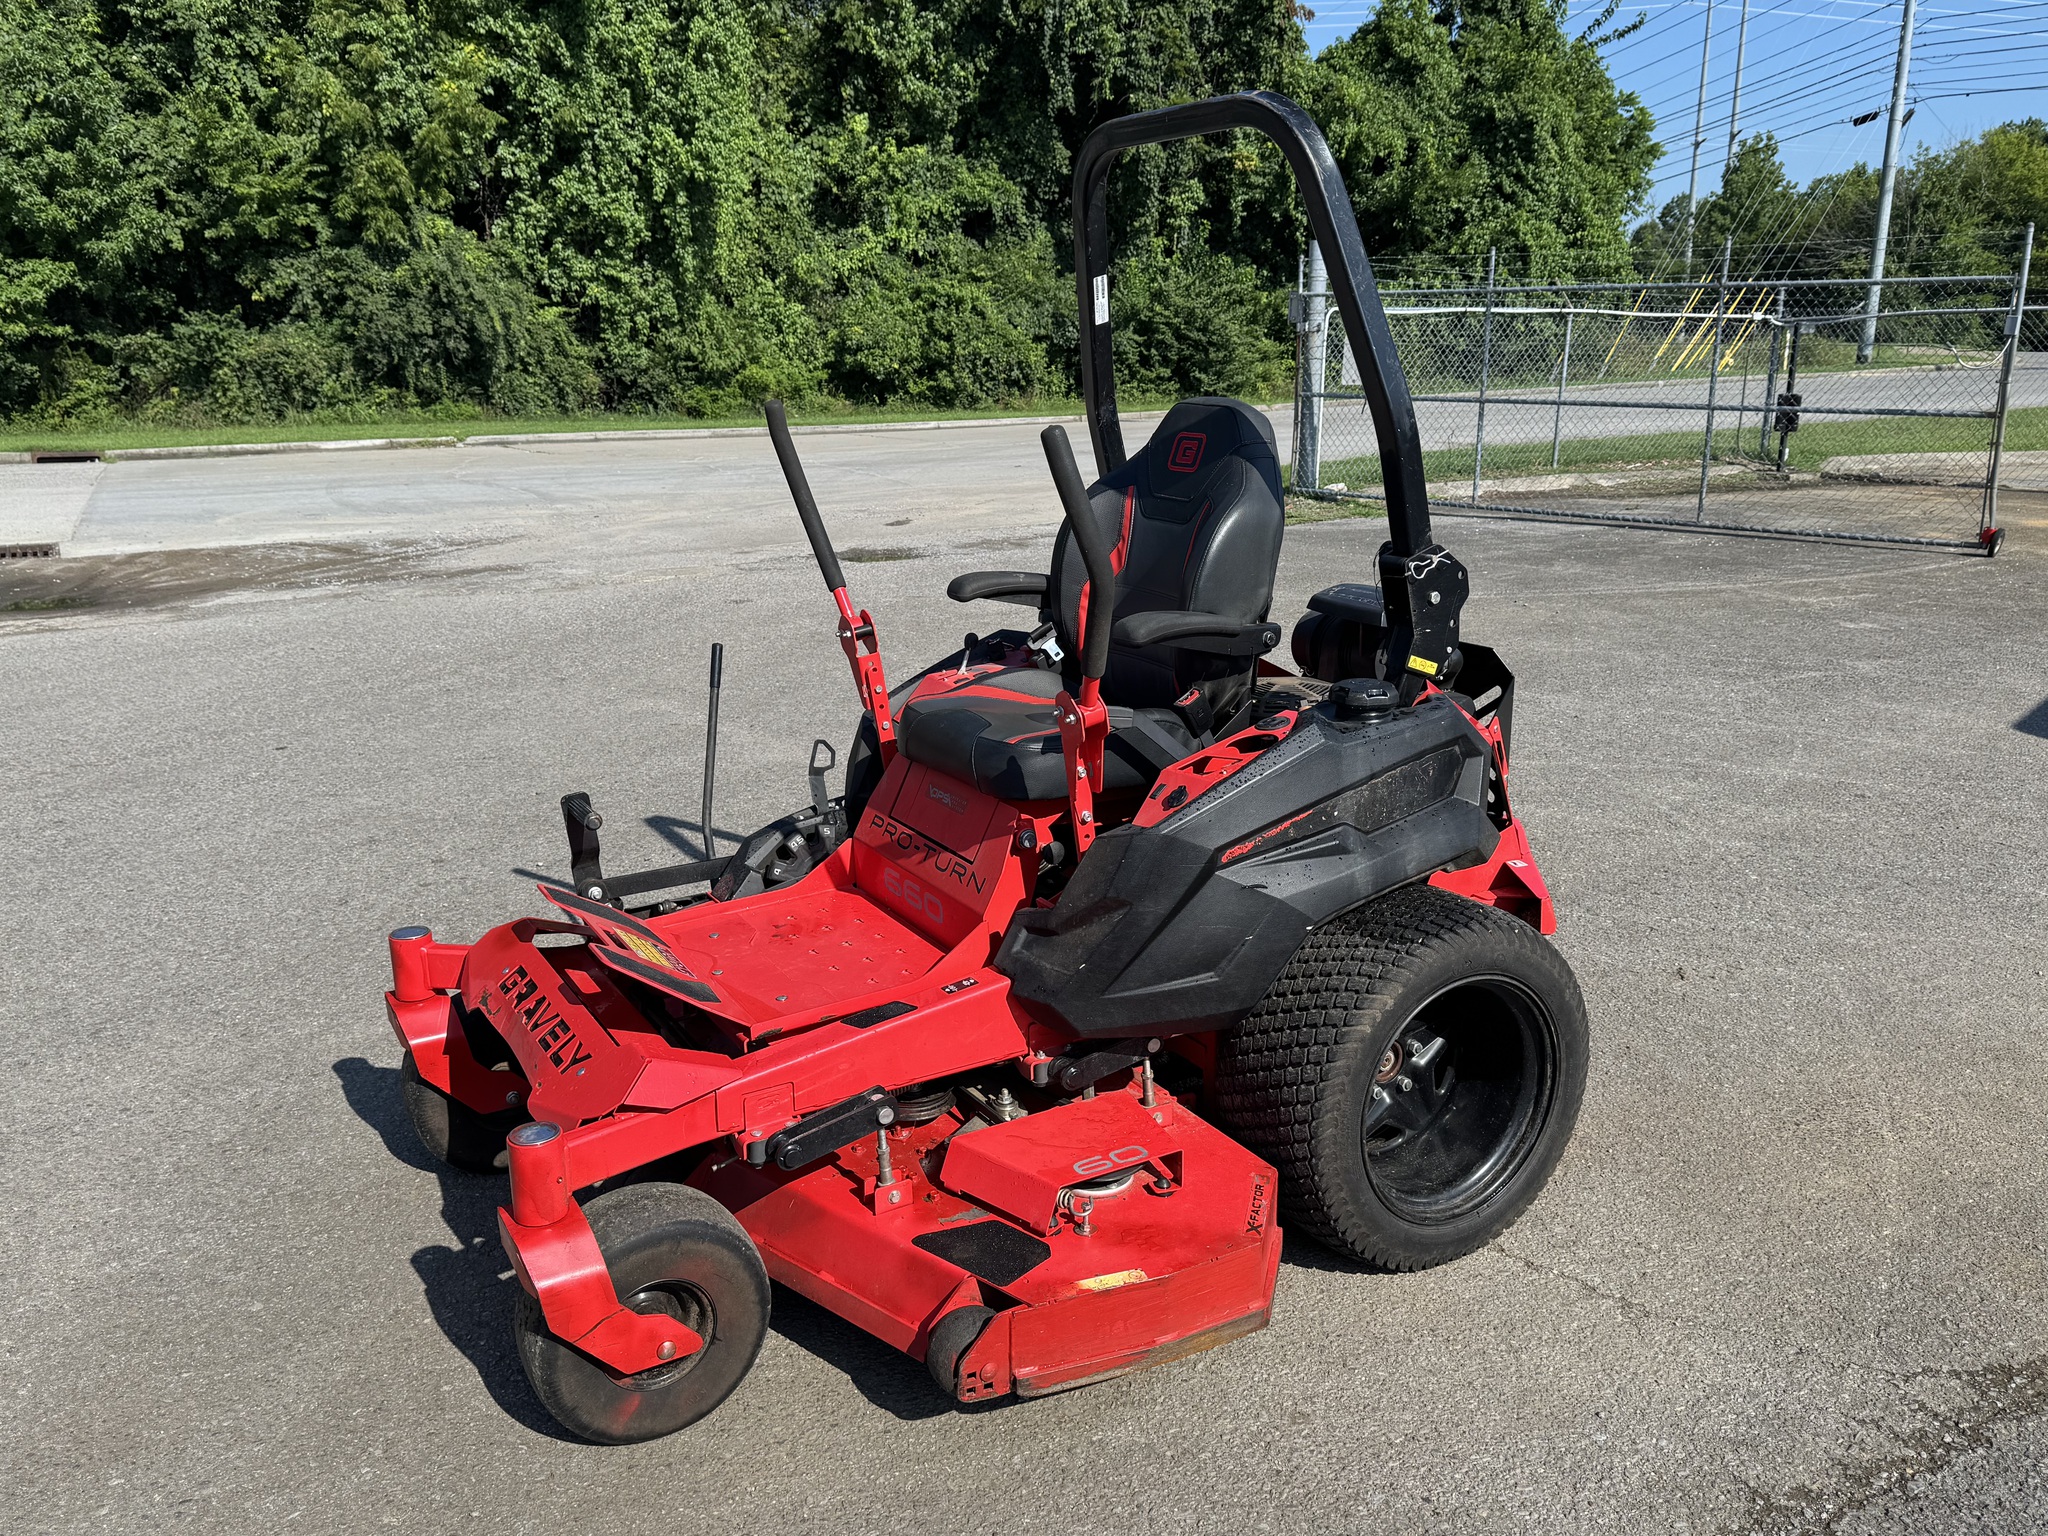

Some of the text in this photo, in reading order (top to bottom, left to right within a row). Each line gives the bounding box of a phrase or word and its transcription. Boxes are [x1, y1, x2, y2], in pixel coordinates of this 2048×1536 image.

[1176, 440, 1199, 464] G
[869, 814, 987, 895] PRO-TURN
[884, 867, 944, 924] 660
[498, 964, 593, 1076] GRAVELY
[1073, 1145, 1149, 1175] 60
[1246, 1183, 1265, 1237] X-FACTOR
